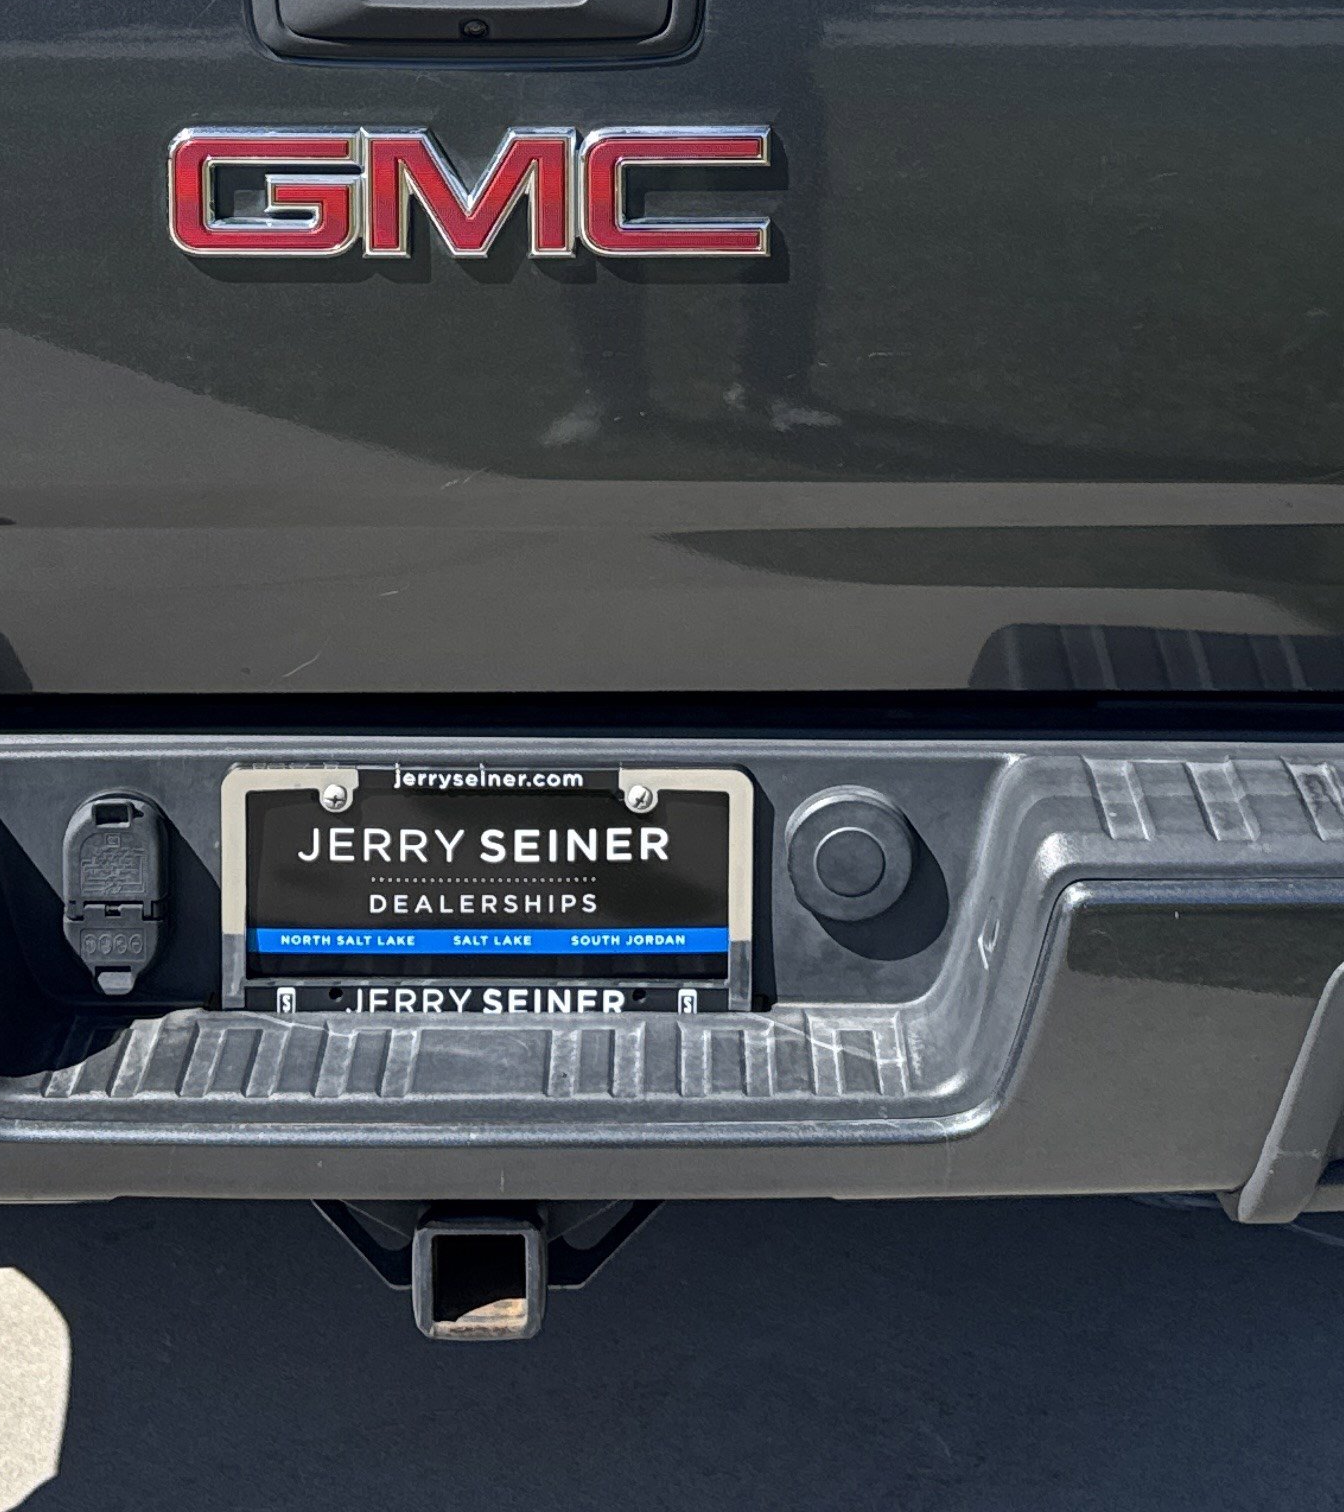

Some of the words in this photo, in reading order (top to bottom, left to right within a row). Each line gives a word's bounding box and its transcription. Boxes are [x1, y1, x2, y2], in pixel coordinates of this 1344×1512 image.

[168, 125, 771, 259] GMC
[394, 764, 584, 789] jerryseiner.com
[297, 828, 465, 863] JERRY
[480, 827, 670, 863] SEINER
[369, 893, 598, 914] DEALERSHIPS
[280, 934, 331, 946] NORTH
[336, 934, 372, 946] SALT
[377, 934, 416, 946] LAKE
[453, 934, 489, 946] SALT
[494, 934, 532, 946] LAKE
[570, 934, 620, 946] SOUTH
[624, 934, 686, 946] JORDAN
[345, 988, 472, 1014] JERRY
[482, 987, 626, 1015] SEINER
